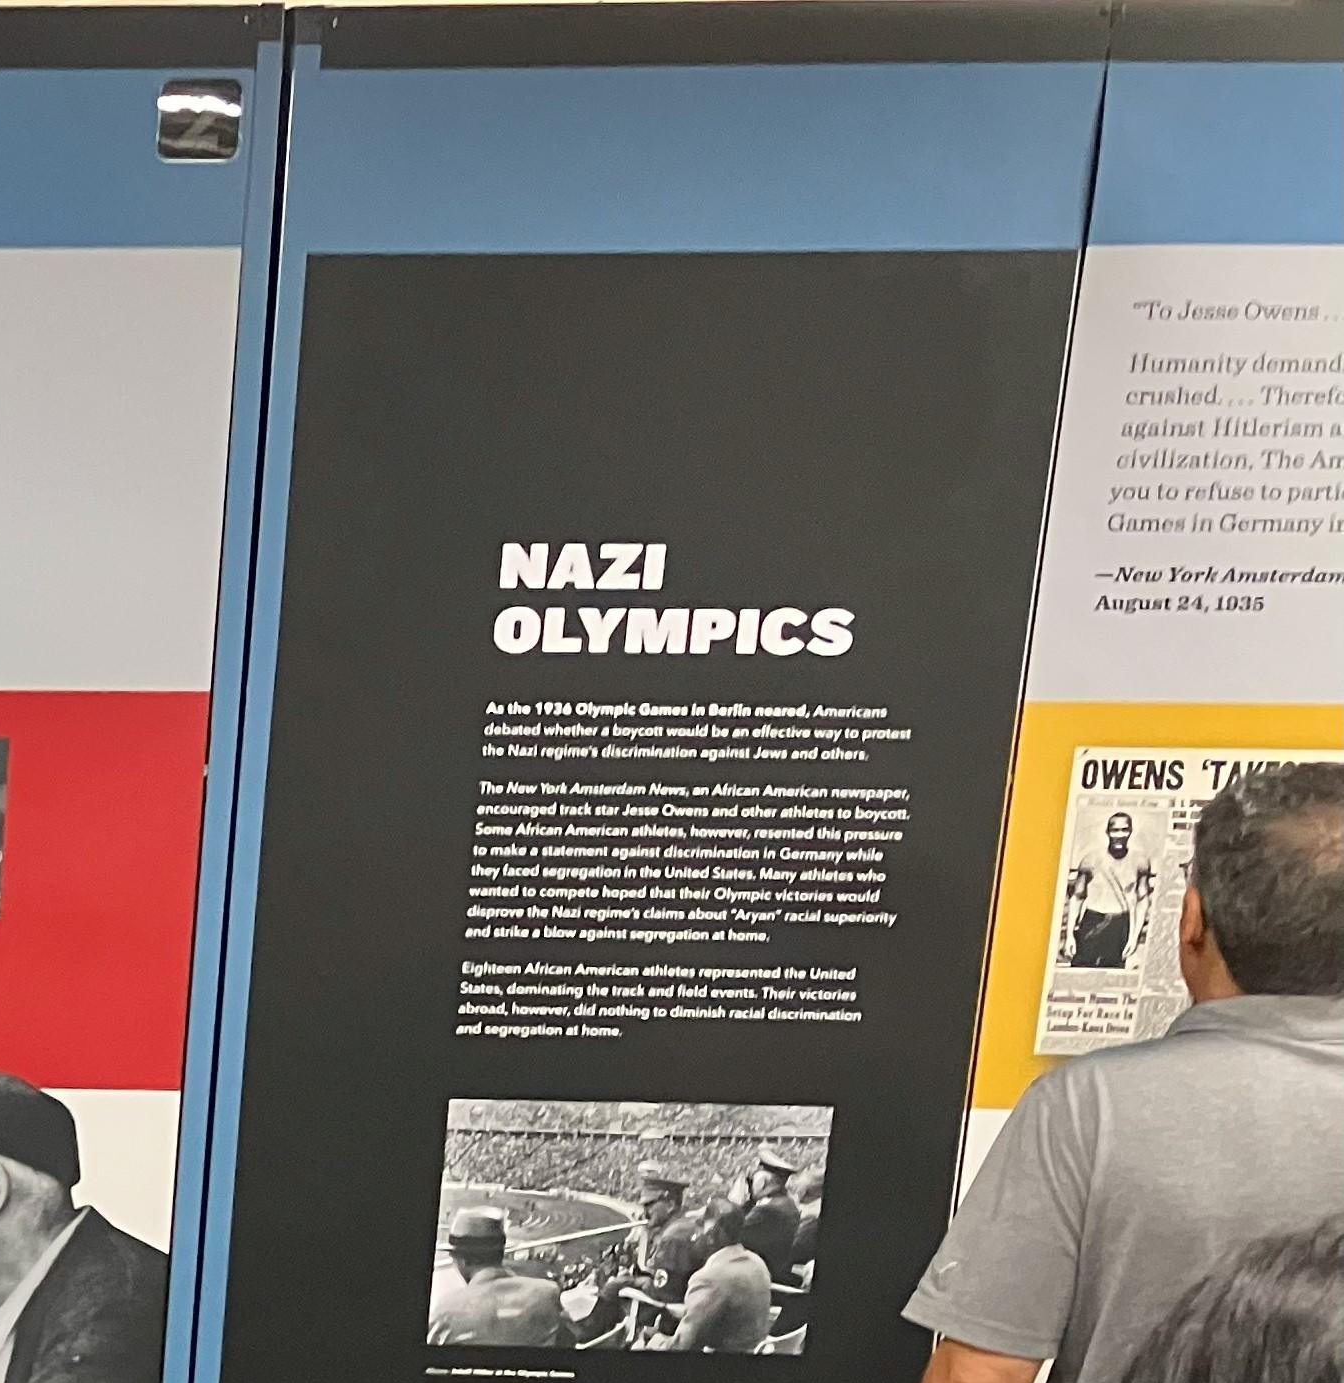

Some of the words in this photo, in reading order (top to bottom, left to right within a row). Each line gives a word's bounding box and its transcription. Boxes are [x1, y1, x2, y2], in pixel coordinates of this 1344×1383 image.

[1177, 301, 1239, 321] Jesse
[1244, 301, 1319, 321] Owens
[1129, 352, 1247, 377] Humanity
[1253, 352, 1344, 374] demand
[1120, 419, 1204, 442] against
[1212, 416, 1323, 438] Hitlerism
[1260, 449, 1304, 470] The
[1108, 485, 1151, 505] you
[1156, 483, 1179, 501] to
[1185, 480, 1254, 501] refuse
[1261, 484, 1282, 501] to
[1287, 482, 1344, 505] parti
[1107, 511, 1185, 533] Games
[1191, 512, 1213, 533] in
[1219, 511, 1324, 537] Germany
[498, 542, 667, 591] NAZI
[1168, 565, 1217, 584] York
[1094, 594, 1172, 614] August
[1177, 595, 1210, 614] 24,
[1215, 594, 1265, 612] 1935
[493, 605, 856, 657] OLYMPICS
[486, 701, 505, 715] As
[507, 701, 532, 716] the
[535, 702, 573, 716] 1936
[575, 702, 636, 718] Olympic
[639, 703, 689, 717] Games
[691, 703, 706, 717] in
[708, 703, 752, 718] Berlin
[754, 704, 811, 719] neared,
[813, 705, 888, 719] Americans
[483, 722, 542, 736] debated
[543, 723, 599, 737] whether
[600, 726, 611, 737] a
[612, 723, 664, 741] boycott
[666, 724, 709, 738] would
[711, 724, 730, 738] be
[731, 728, 750, 738] an
[752, 724, 812, 739] effective
[814, 728, 843, 742] way
[844, 727, 860, 739] to
[862, 728, 912, 742] protest
[482, 743, 505, 757] the
[507, 744, 538, 758] Nazi
[601, 744, 698, 759] discrimination
[700, 746, 750, 762] against
[752, 747, 788, 760] Jews
[790, 747, 818, 761] and
[1081, 759, 1185, 790] OWENS
